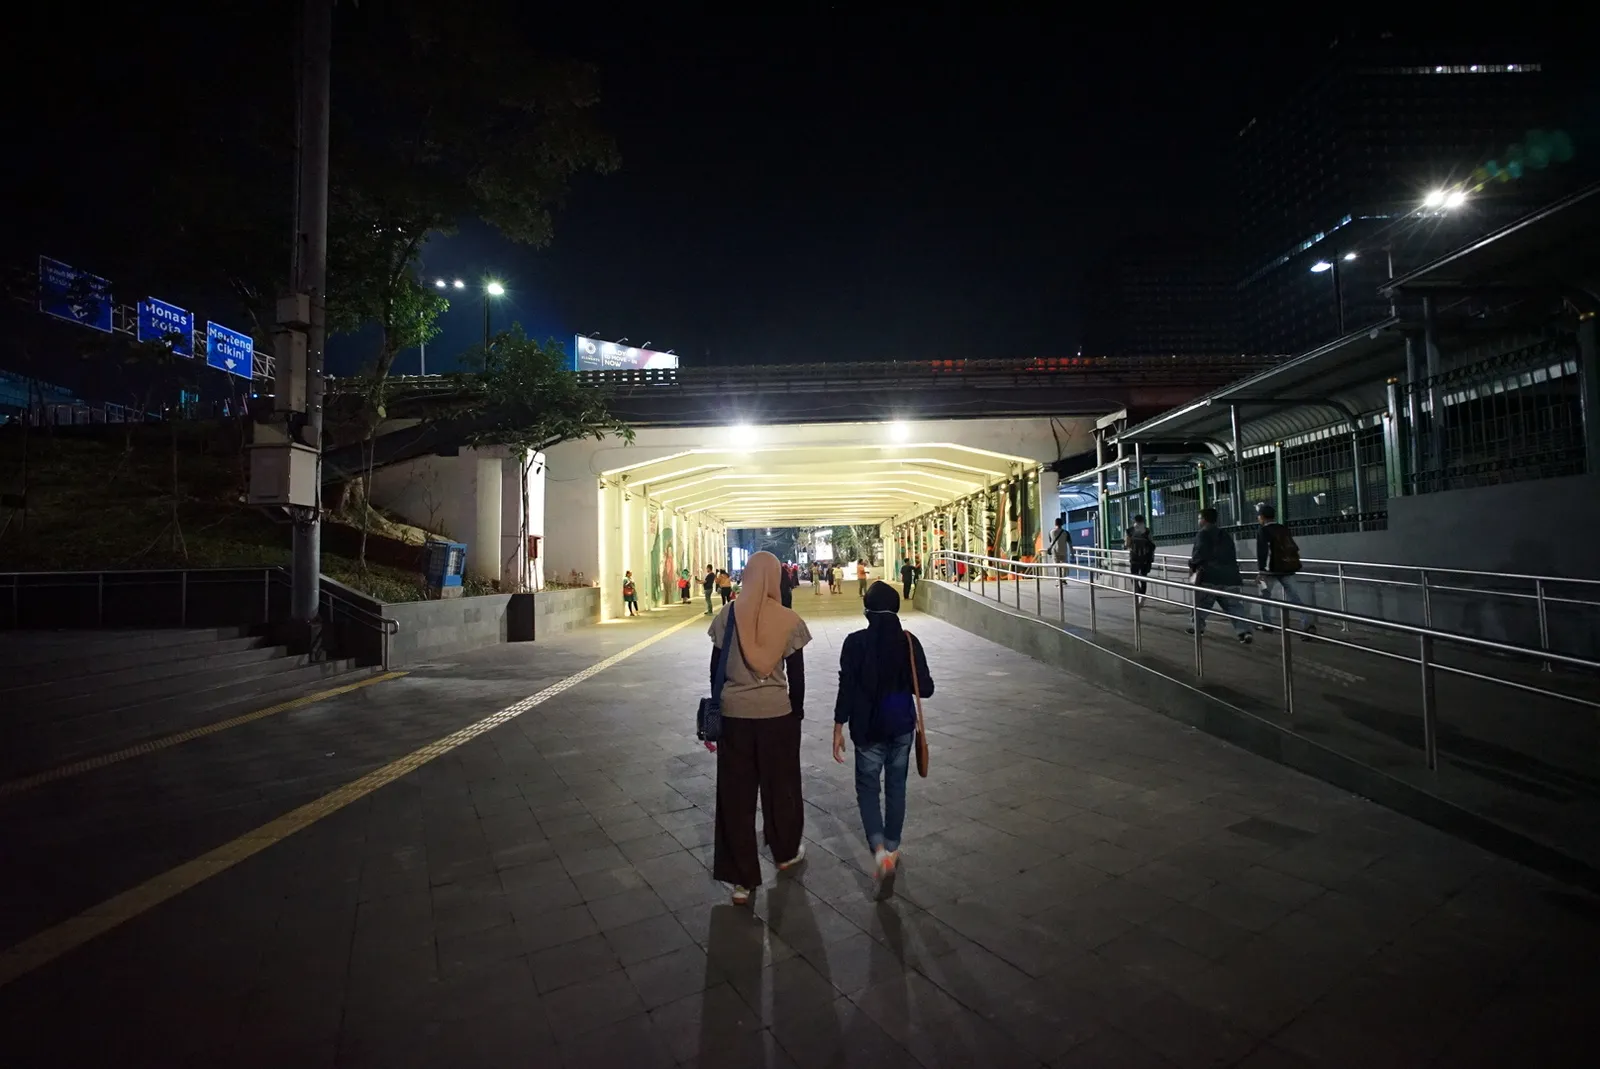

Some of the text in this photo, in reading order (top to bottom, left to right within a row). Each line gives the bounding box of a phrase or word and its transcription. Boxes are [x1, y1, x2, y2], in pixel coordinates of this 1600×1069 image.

[146, 303, 187, 326] Monas
[217, 343, 244, 361] Cikini
[604, 359, 622, 368] NOW
